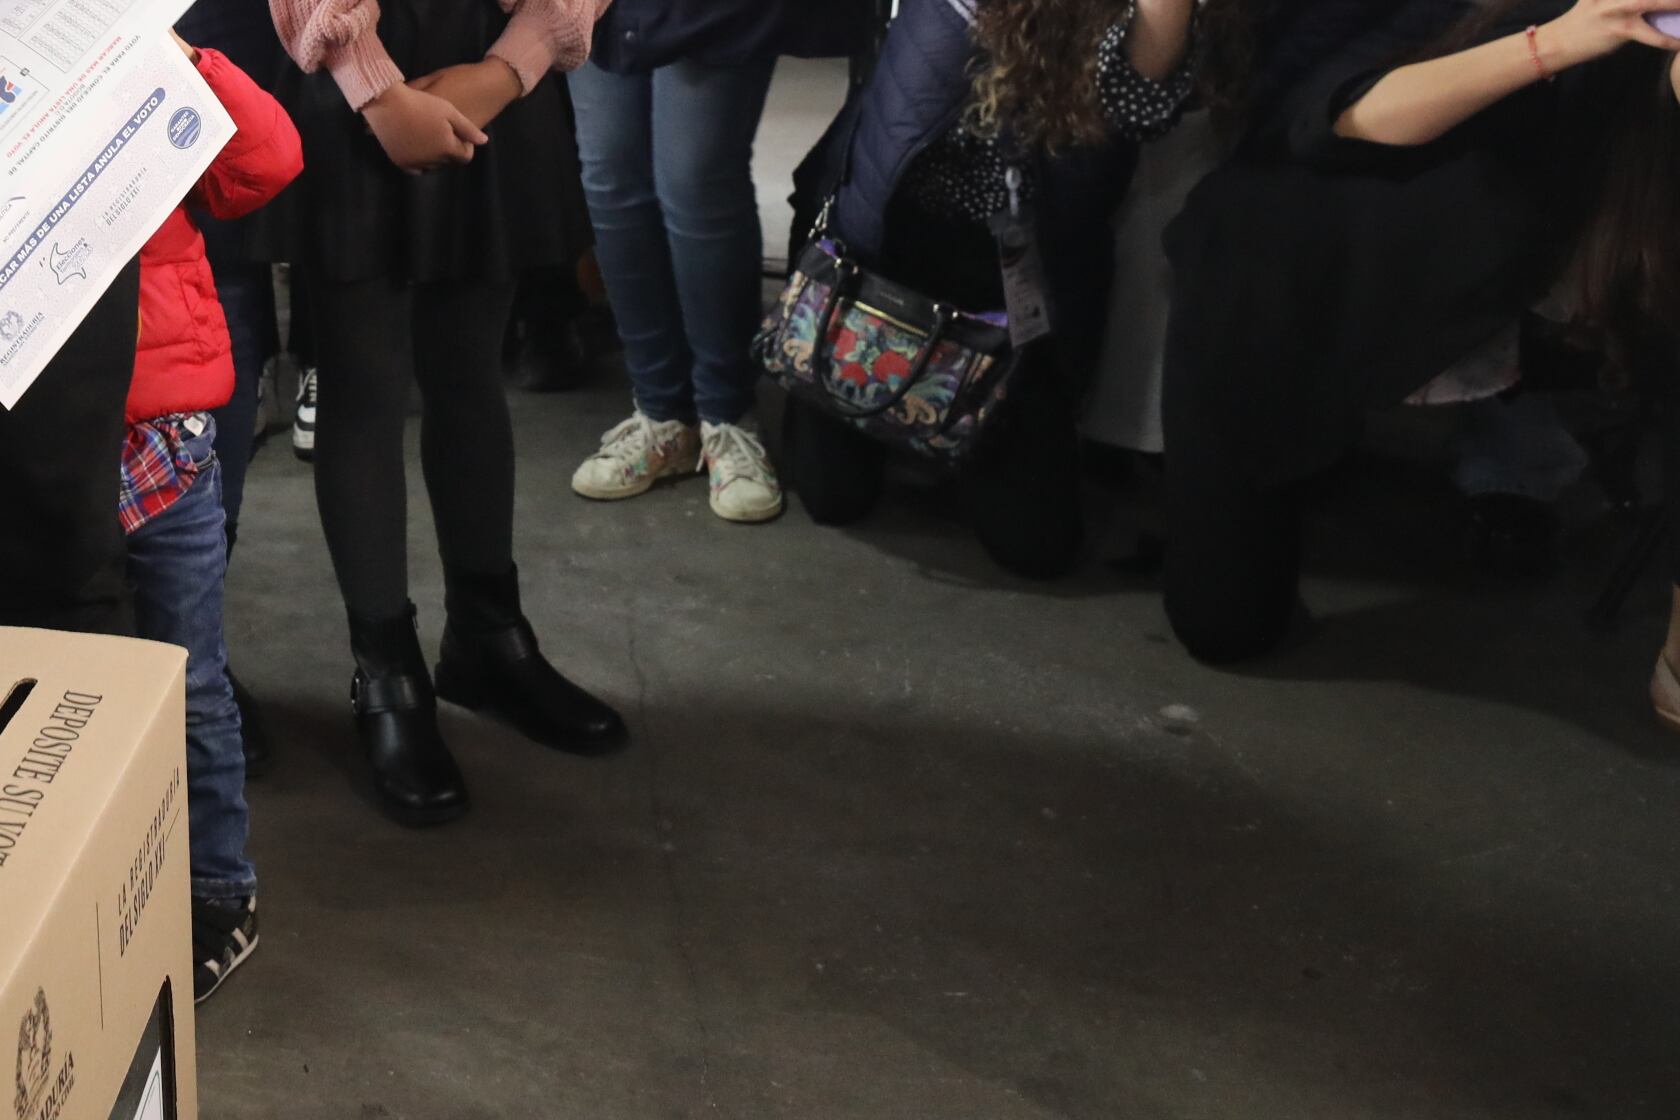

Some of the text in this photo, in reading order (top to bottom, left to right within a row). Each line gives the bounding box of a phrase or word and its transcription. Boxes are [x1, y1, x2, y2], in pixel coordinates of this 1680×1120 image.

[14, 235, 38, 262] MÁS
[35, 222, 52, 239] DE
[48, 200, 71, 224] UNA
[67, 170, 96, 201] LISTA
[91, 137, 124, 173] ANULA
[120, 122, 136, 139] EL
[132, 95, 160, 125] VOTO
[113, 195, 131, 215] SIGLO
[54, 235, 85, 270] Elecciones
[12, 689, 103, 784] DEPOSITE
[119, 767, 180, 916] LA REGISTRADURÍA
[120, 832, 165, 958] DEL SIGLO XXI
